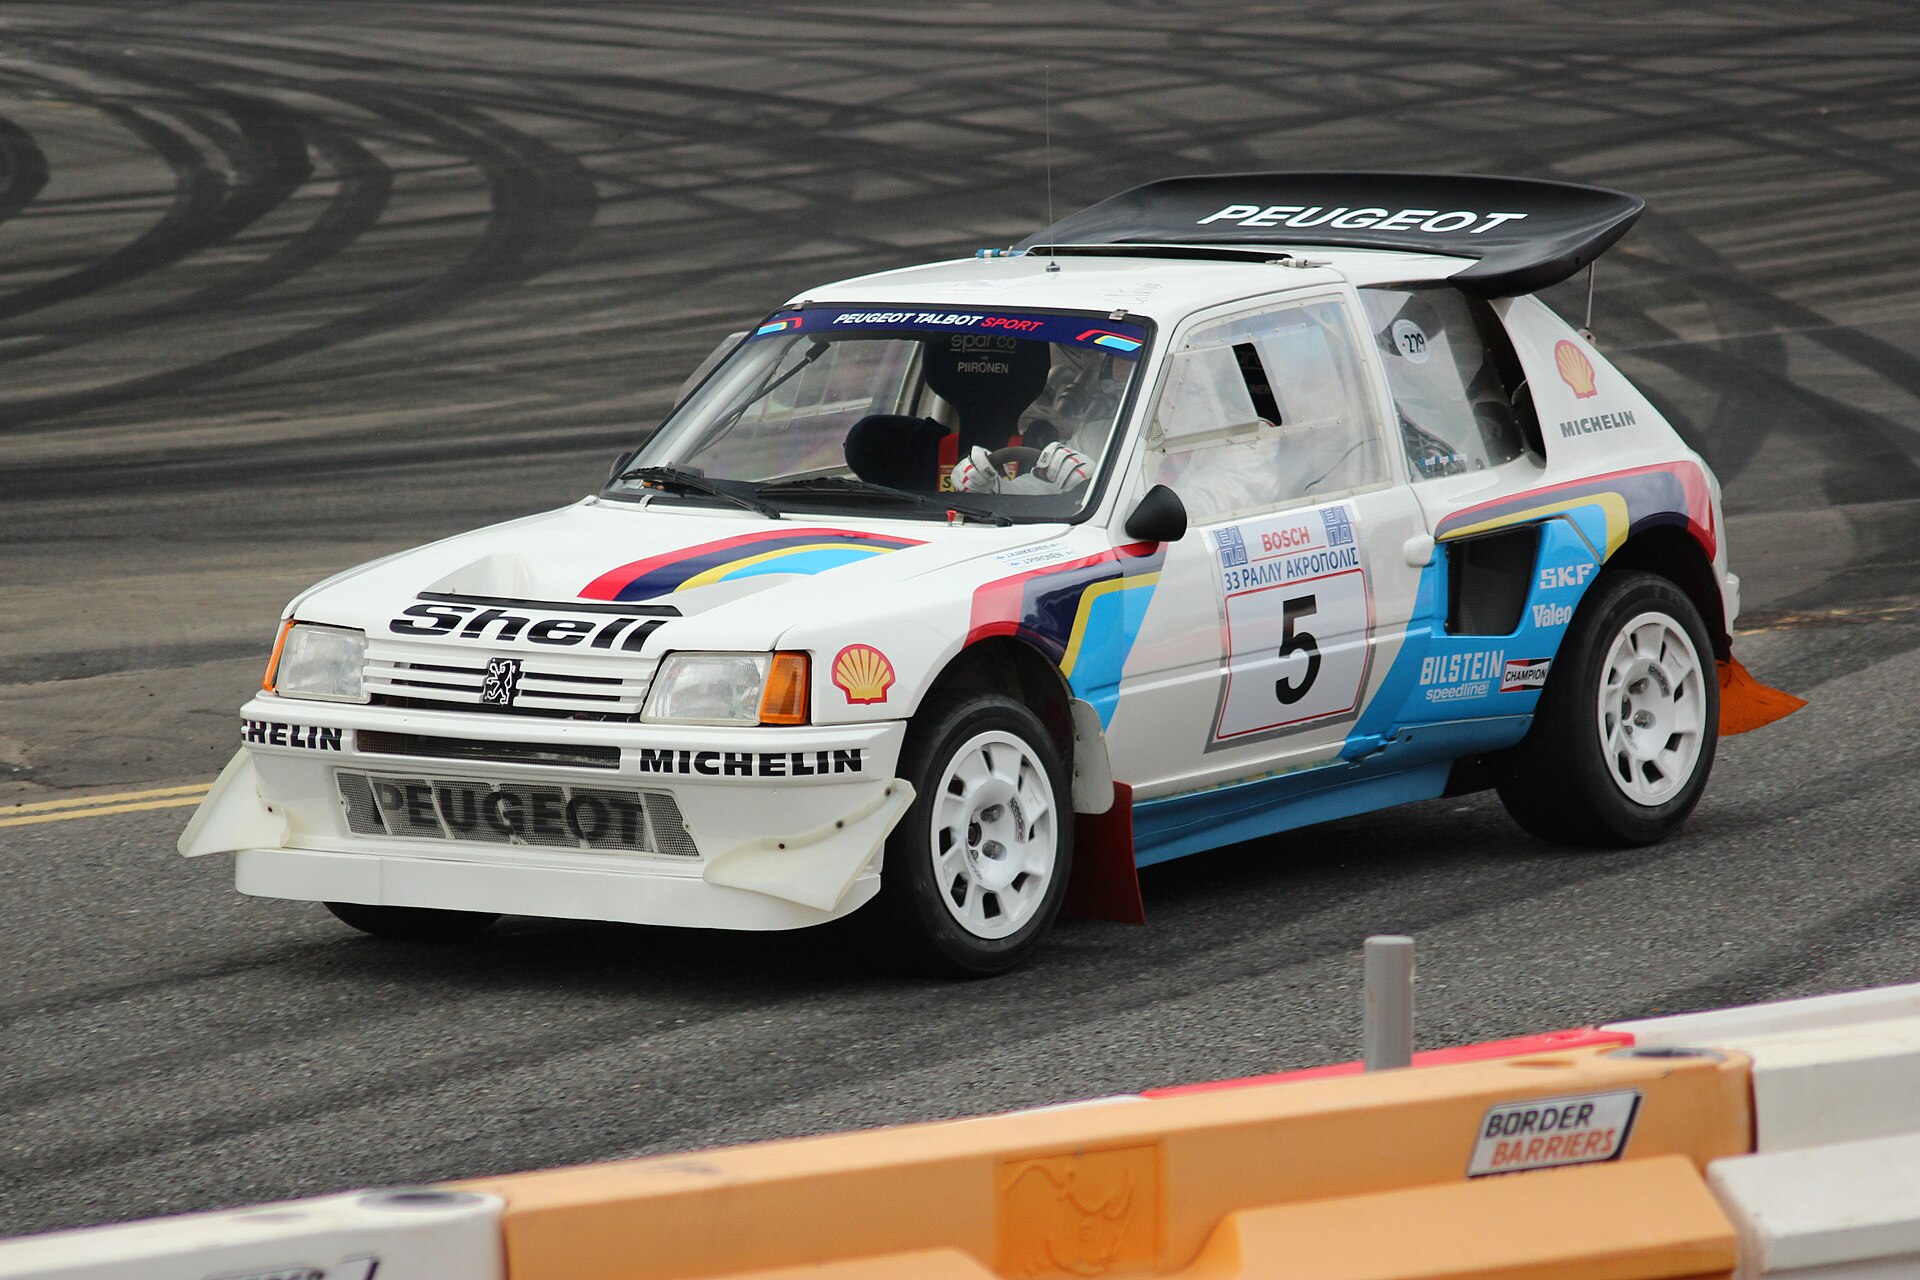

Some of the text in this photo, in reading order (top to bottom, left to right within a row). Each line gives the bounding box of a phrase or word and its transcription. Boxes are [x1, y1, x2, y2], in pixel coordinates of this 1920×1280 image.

[1197, 204, 1528, 234] PEUGEOT
[832, 312, 1044, 332] PEUGEOT TALBOT SPORT
[950, 334, 1017, 353] sparco
[1404, 332, 1425, 353] 229
[957, 362, 1009, 375] PIIRONEN
[1560, 410, 1637, 438] MICHELIN
[1261, 526, 1311, 552] BOSCH
[1224, 571, 1240, 591] 33
[1539, 563, 1596, 590] SKF
[389, 603, 670, 653] Shell
[1531, 603, 1572, 629] Valeo
[1275, 594, 1322, 705] 5
[1419, 650, 1505, 686] BILSTEIN
[1505, 669, 1547, 682] CHAMPION
[1425, 682, 1488, 701] speedline
[640, 748, 863, 777] MICHELIN
[372, 782, 644, 844] PEUGEOT
[1485, 1103, 1595, 1138] BORDER
[1490, 1127, 1616, 1168] BARRIERS
